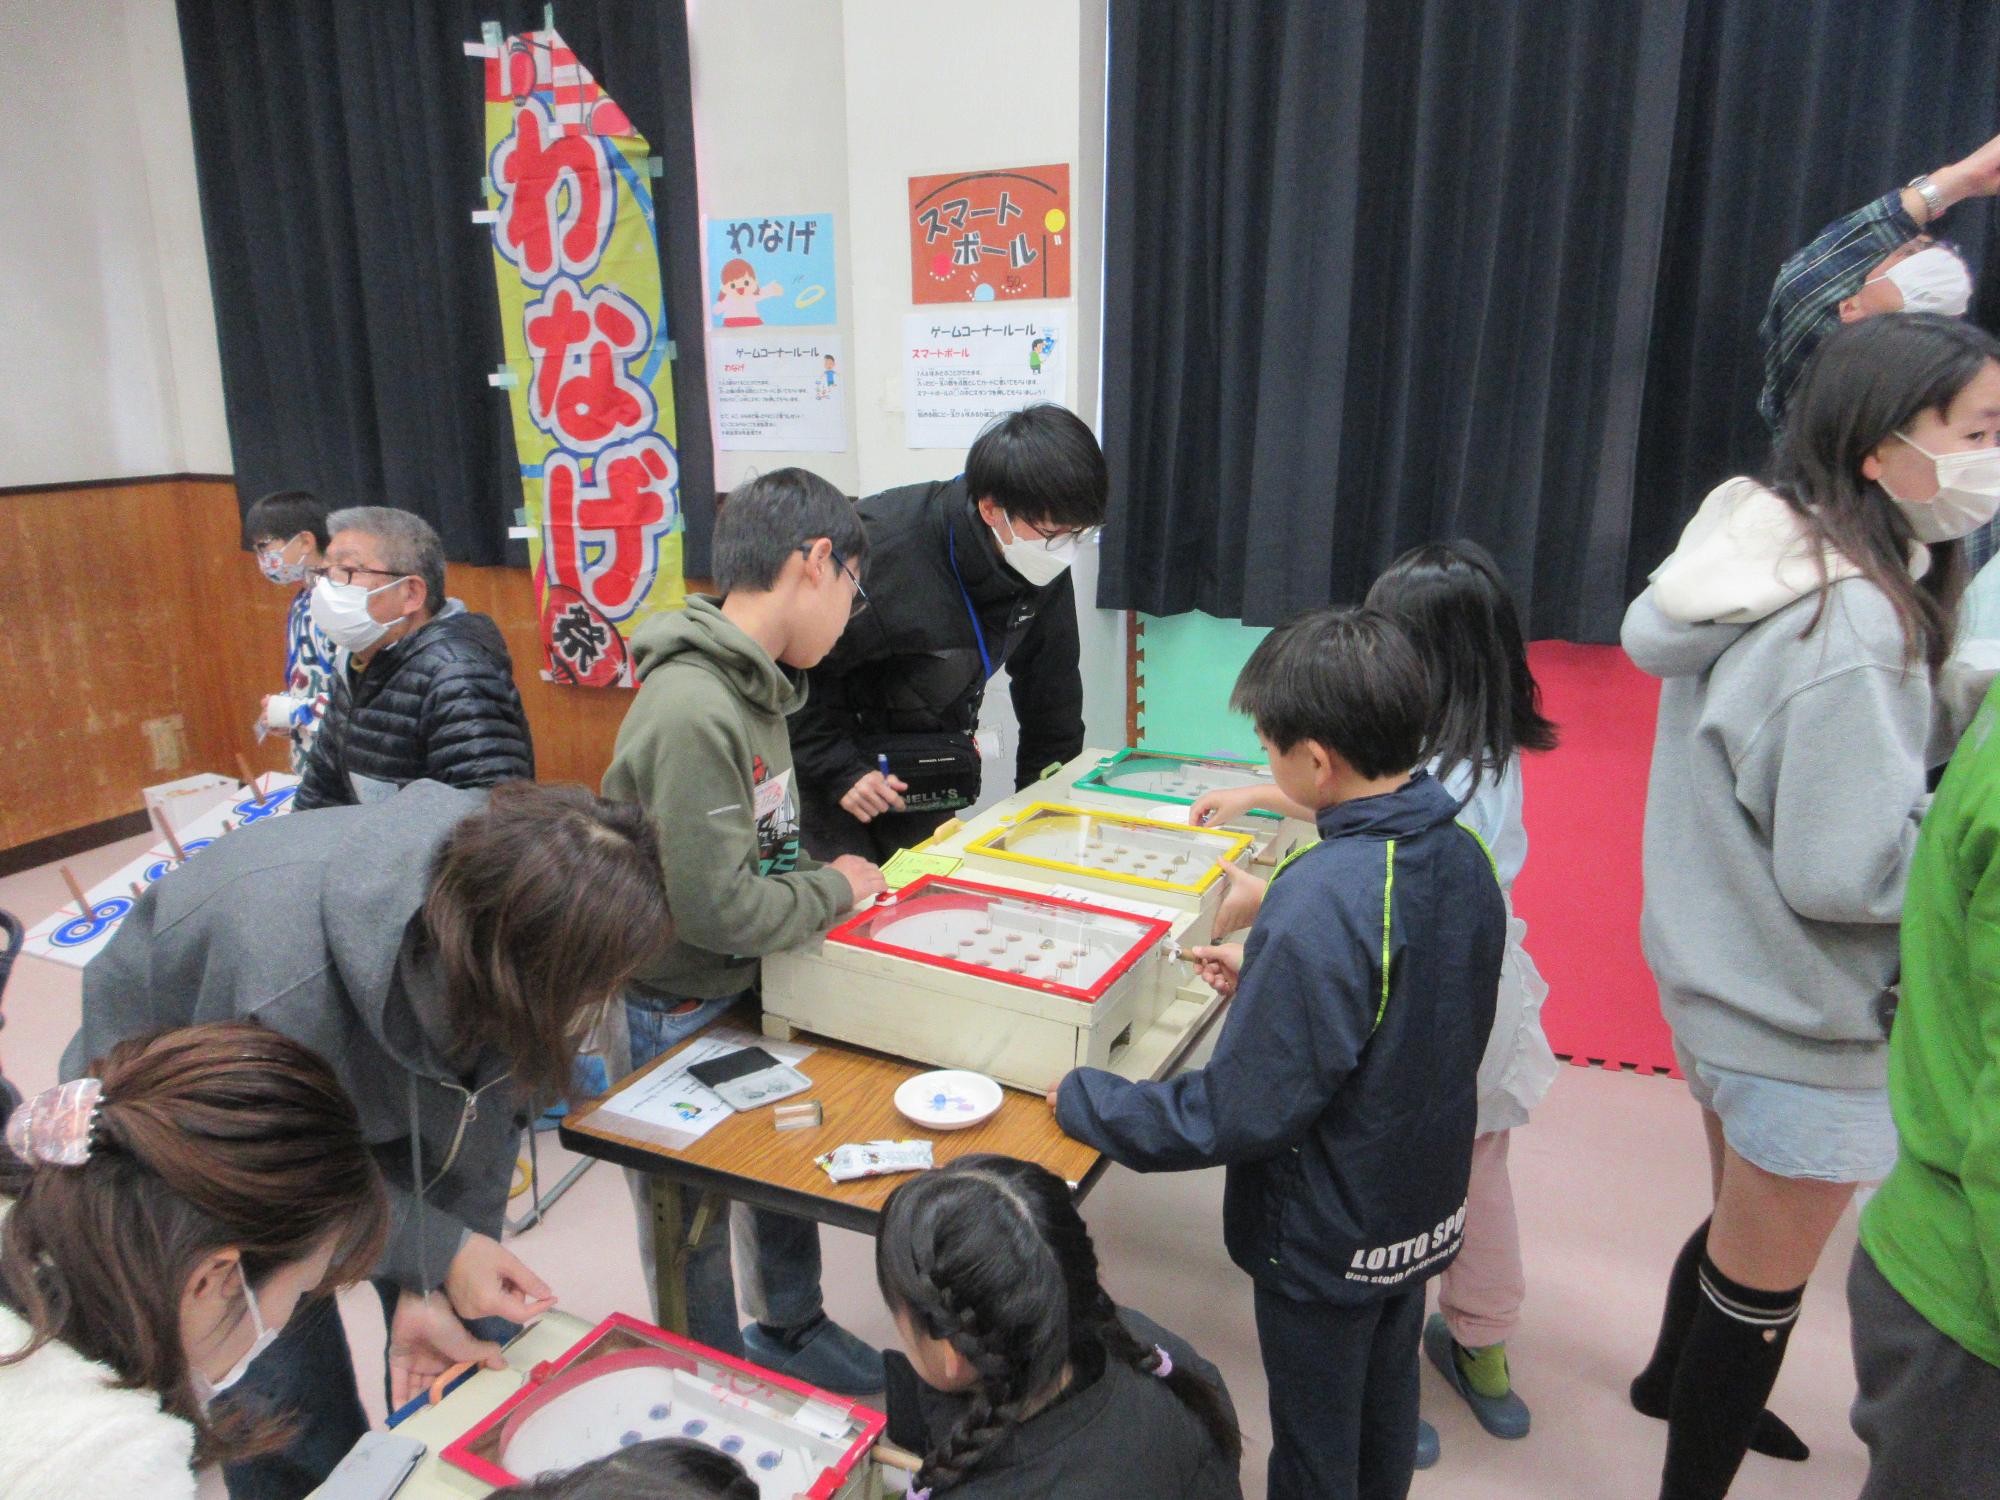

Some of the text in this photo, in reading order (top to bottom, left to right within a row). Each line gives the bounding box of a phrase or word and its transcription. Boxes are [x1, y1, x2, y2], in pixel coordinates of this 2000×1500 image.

[726, 219, 817, 255] わなげ
[918, 192, 1022, 244] スマート
[952, 231, 1038, 269] ボール
[930, 323, 1036, 338] ゲームコーナールール
[493, 102, 676, 614] わなげ
[735, 346, 819, 359] ゲームコーナールール
[912, 348, 970, 359] スマートボール
[234, 785, 297, 825] 4
[50, 896, 134, 947] 8
[1350, 1232, 1430, 1270] LOTTO
[1431, 1197, 1468, 1249] SPO
